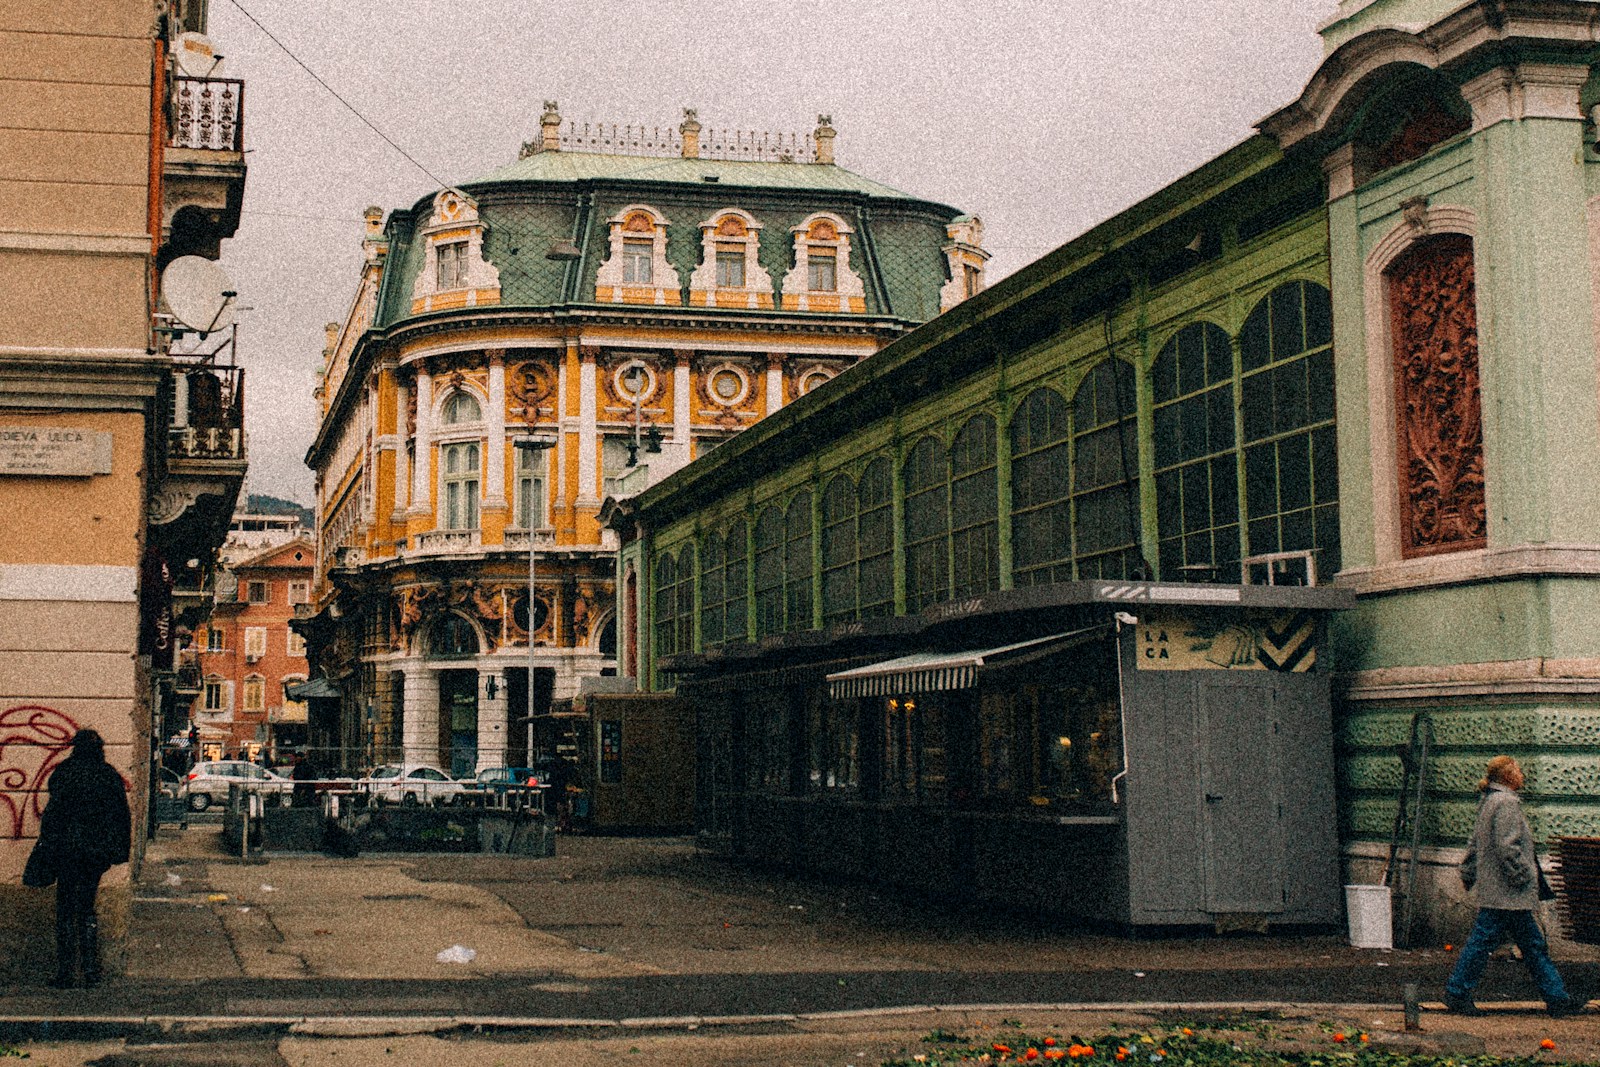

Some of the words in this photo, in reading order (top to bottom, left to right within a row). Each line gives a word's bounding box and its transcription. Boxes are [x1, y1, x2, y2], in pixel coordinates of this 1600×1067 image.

[48, 432, 83, 442] ULICA
[156, 606, 169, 650] Coffee
[1145, 647, 1169, 658] CA
